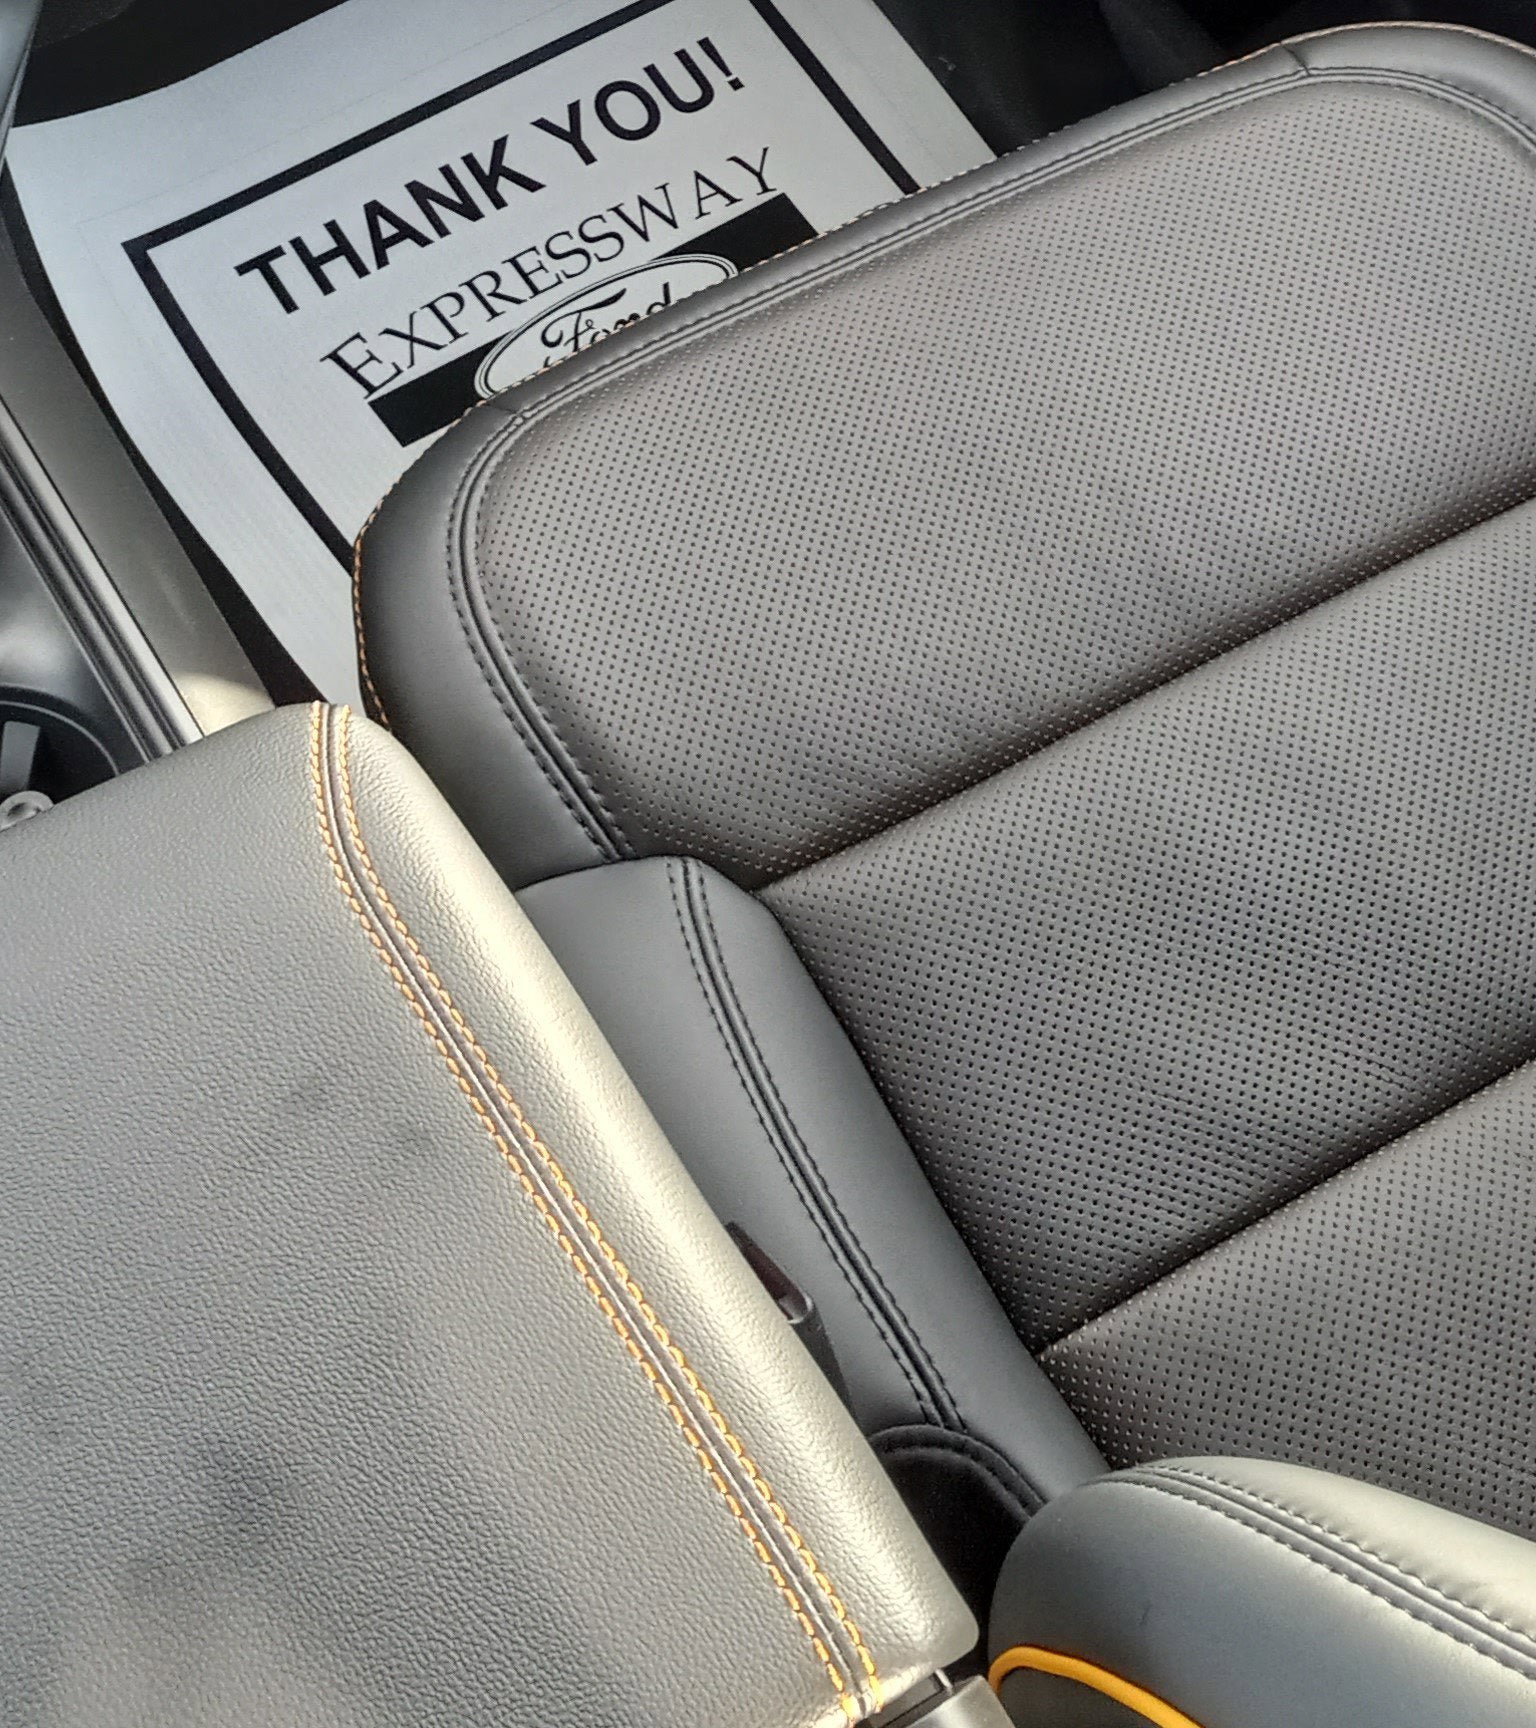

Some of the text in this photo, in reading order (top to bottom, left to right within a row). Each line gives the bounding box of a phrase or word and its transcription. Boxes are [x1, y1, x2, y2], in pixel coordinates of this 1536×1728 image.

[233, 36, 746, 315] THANK YOU!
[318, 145, 779, 402] EXPRESSWAY
